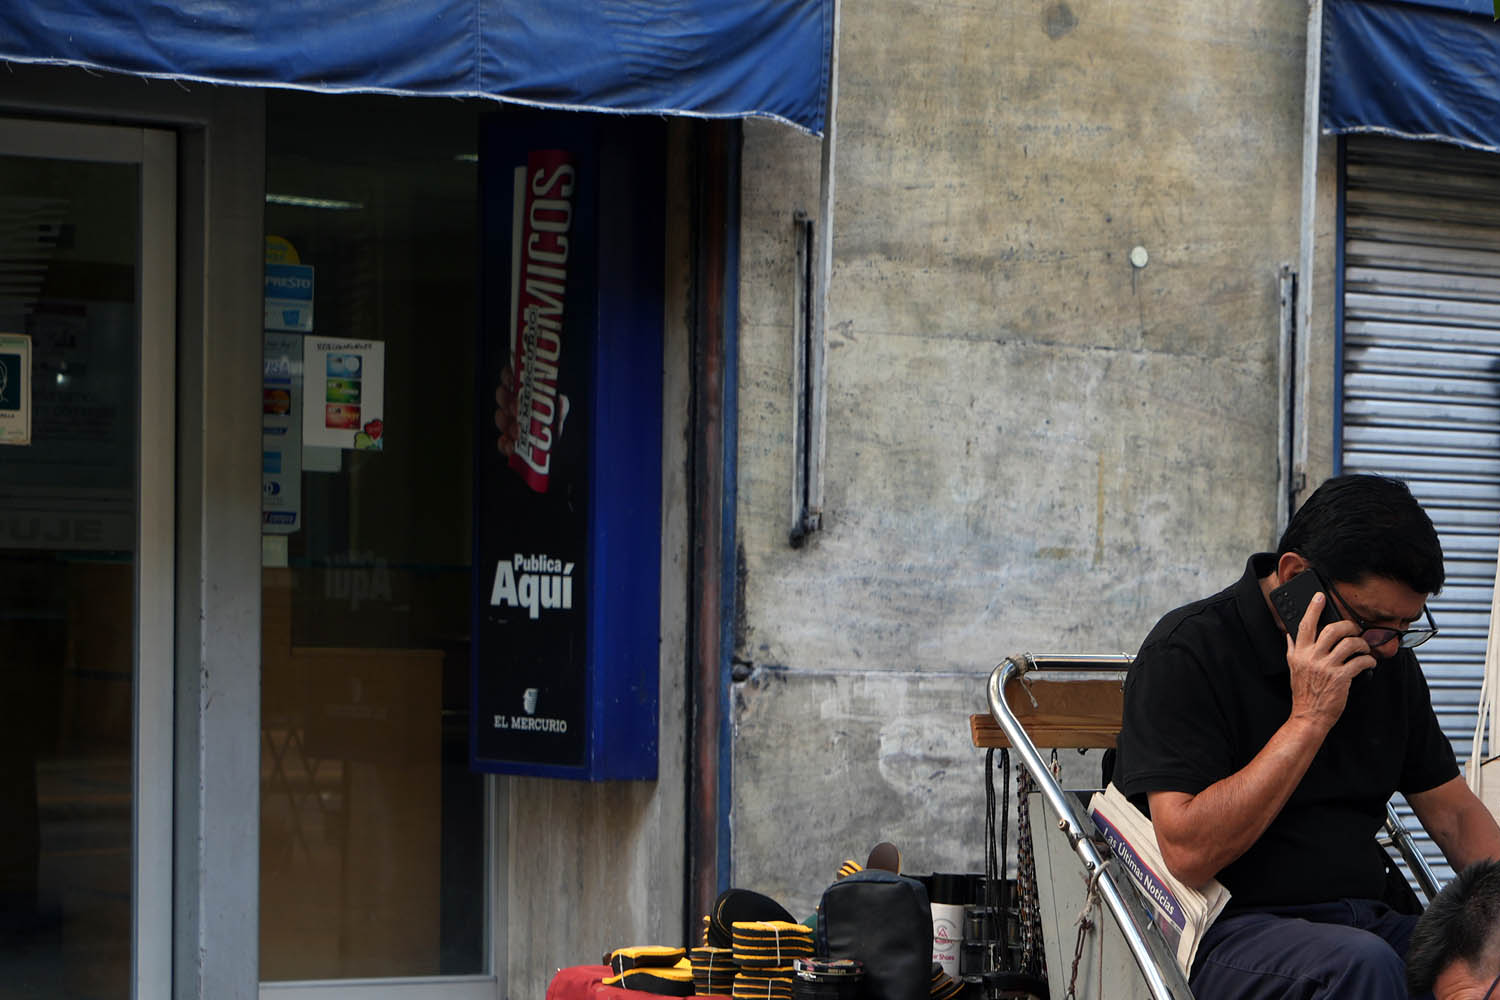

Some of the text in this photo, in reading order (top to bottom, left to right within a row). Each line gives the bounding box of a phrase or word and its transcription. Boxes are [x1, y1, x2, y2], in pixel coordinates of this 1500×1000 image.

[514, 553, 562, 573] Publica
[490, 560, 575, 620] Aquí
[494, 715, 568, 733] EL MERCURIO
[1103, 827, 1175, 915] Las Últimas Noticias
